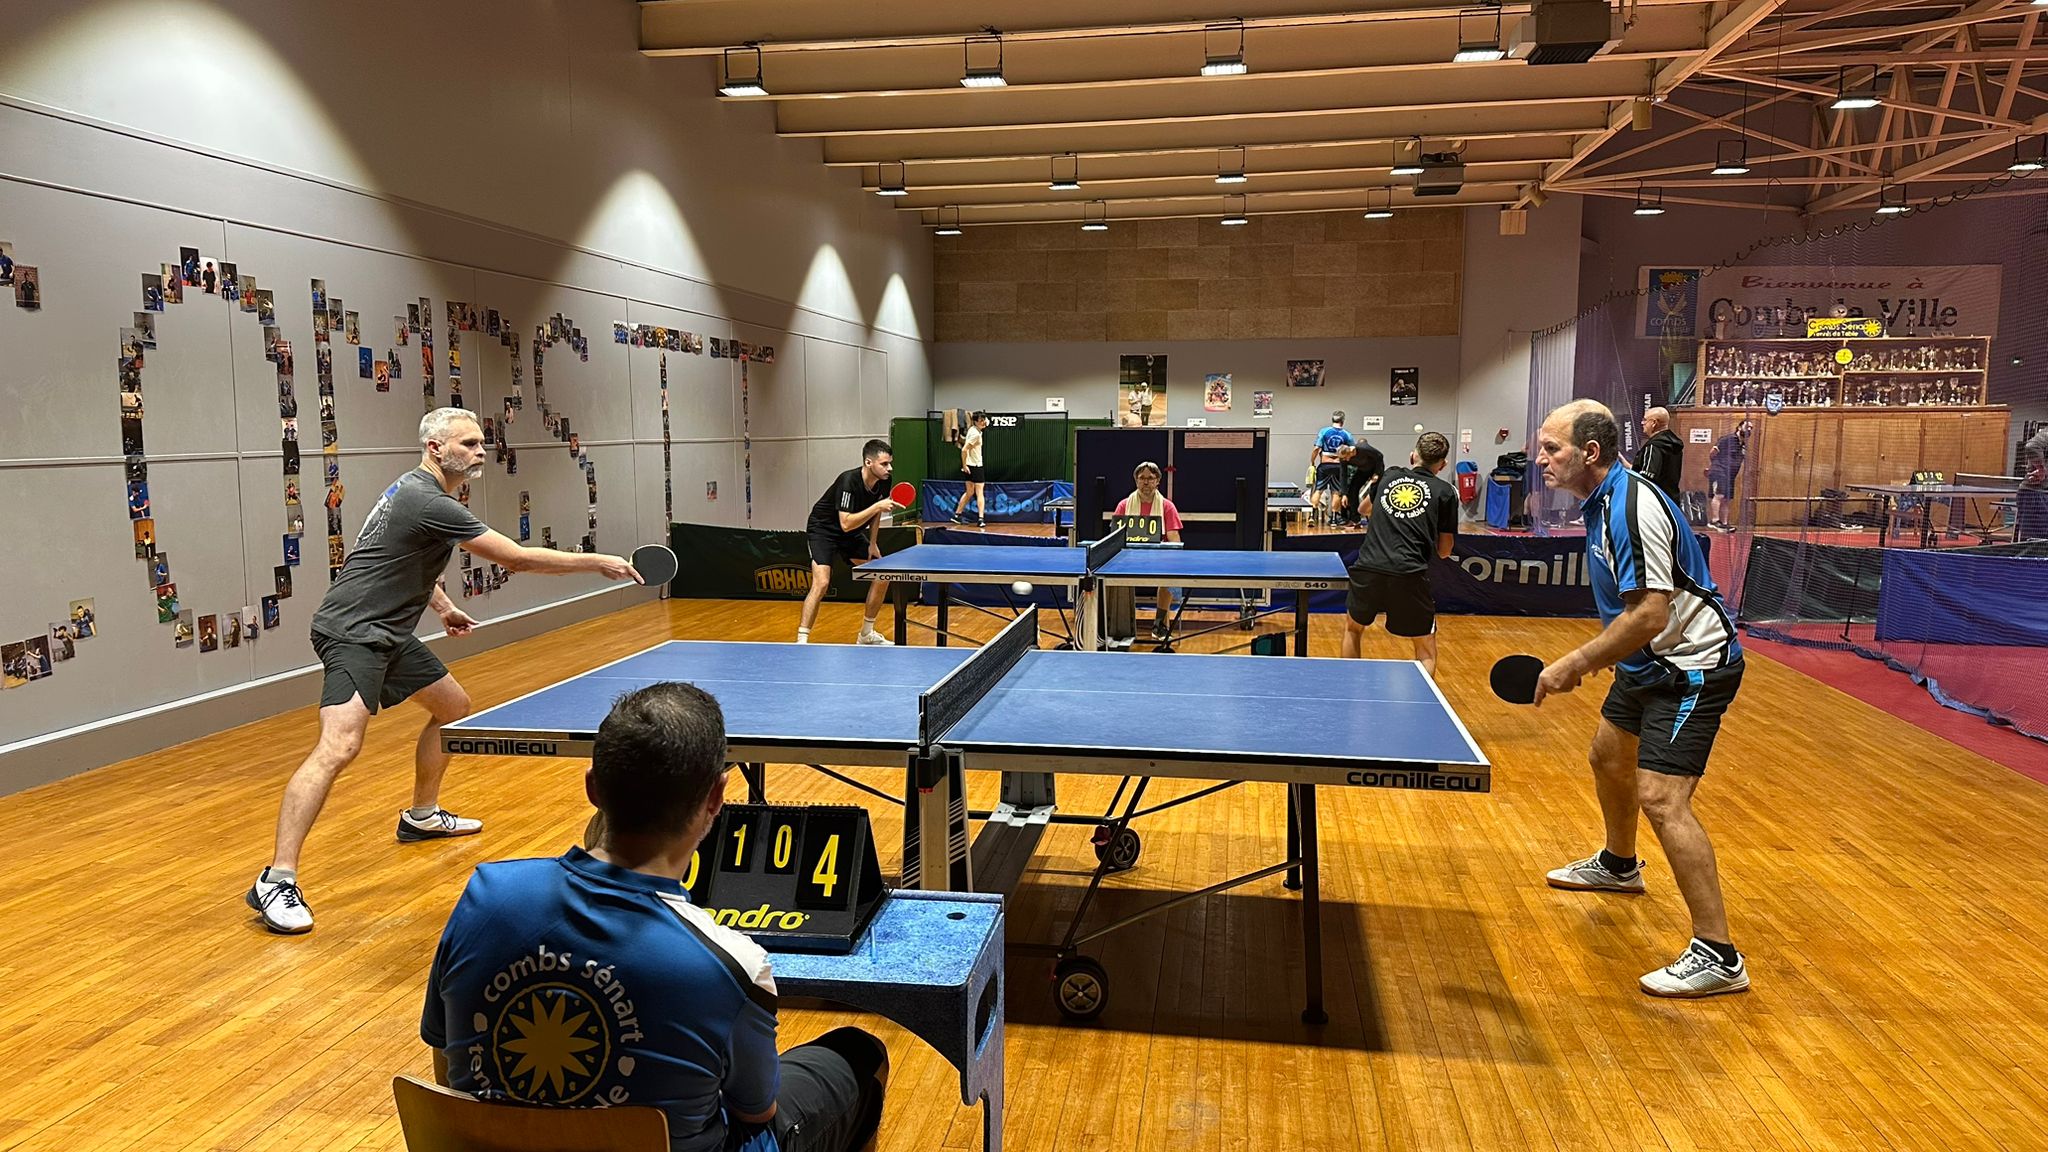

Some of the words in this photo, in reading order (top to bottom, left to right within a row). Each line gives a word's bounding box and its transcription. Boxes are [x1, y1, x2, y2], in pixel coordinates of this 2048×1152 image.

[1741, 275, 1892, 289] Bienvenue
[1907, 277, 1925, 290] à
[1878, 297, 1958, 328] Ville
[991, 416, 1018, 427] TSP
[1624, 421, 1633, 452] TIBHAR
[1388, 476, 1415, 488] combs
[1406, 507, 1426, 519] table
[1149, 519, 1157, 535] 0
[879, 573, 928, 582] cornilleau
[1449, 552, 1590, 587] ornill
[758, 569, 813, 591] TIBHA
[1304, 581, 1328, 589] 540
[448, 740, 557, 755] cornilleau
[1347, 771, 1481, 791] cornilleau
[733, 823, 747, 867] 1
[773, 824, 792, 869] 0
[812, 834, 839, 898] 4
[484, 944, 572, 1003] combs
[580, 959, 644, 1044] sénart
